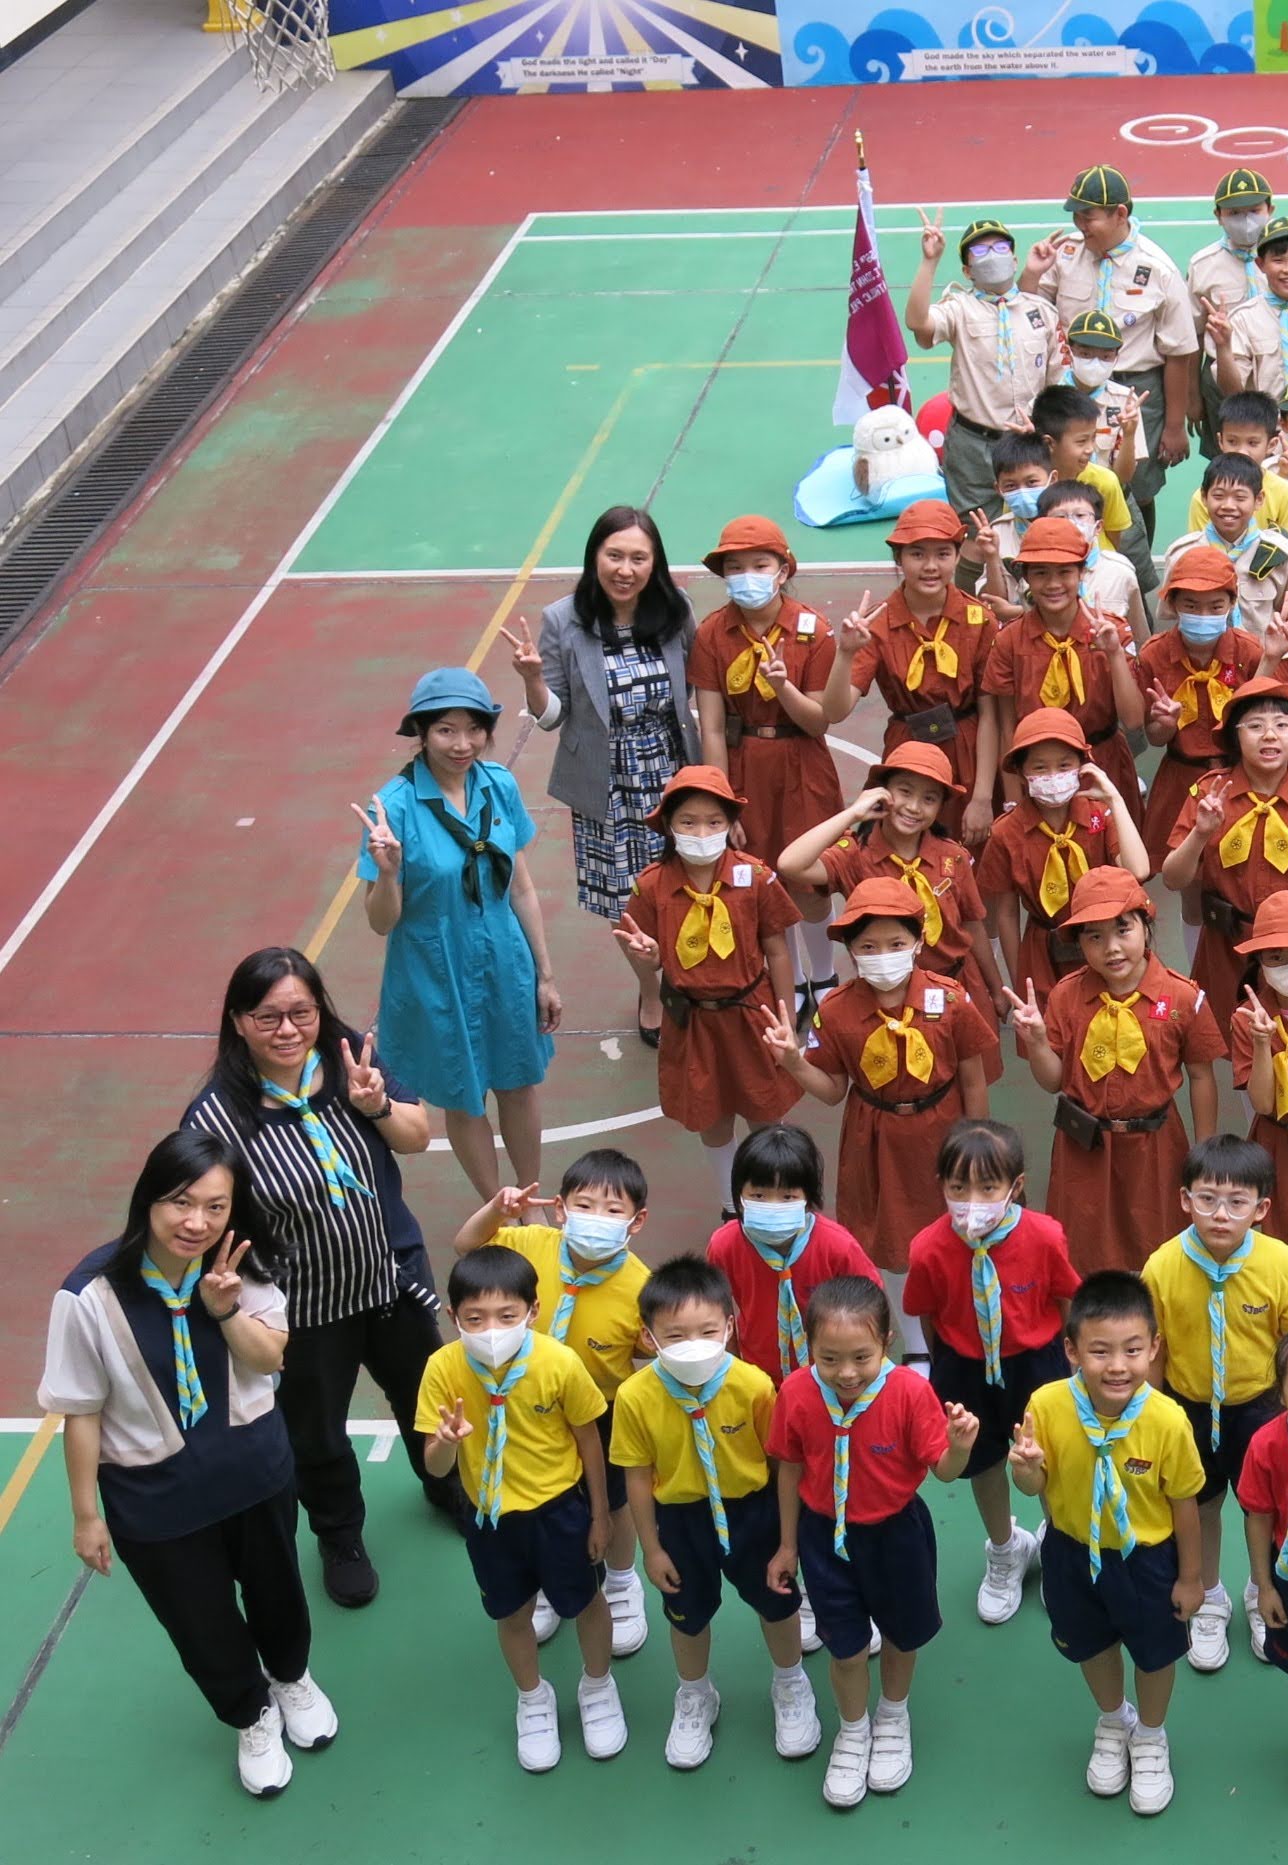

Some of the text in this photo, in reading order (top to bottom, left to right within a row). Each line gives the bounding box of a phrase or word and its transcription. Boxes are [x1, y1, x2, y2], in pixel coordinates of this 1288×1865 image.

[924, 52, 940, 60] God
[982, 52, 995, 60] sky
[1023, 50, 1064, 59] separated
[539, 58, 561, 66] made
[579, 58, 597, 66] light
[540, 69, 576, 77] darkness
[590, 68, 614, 76] called
